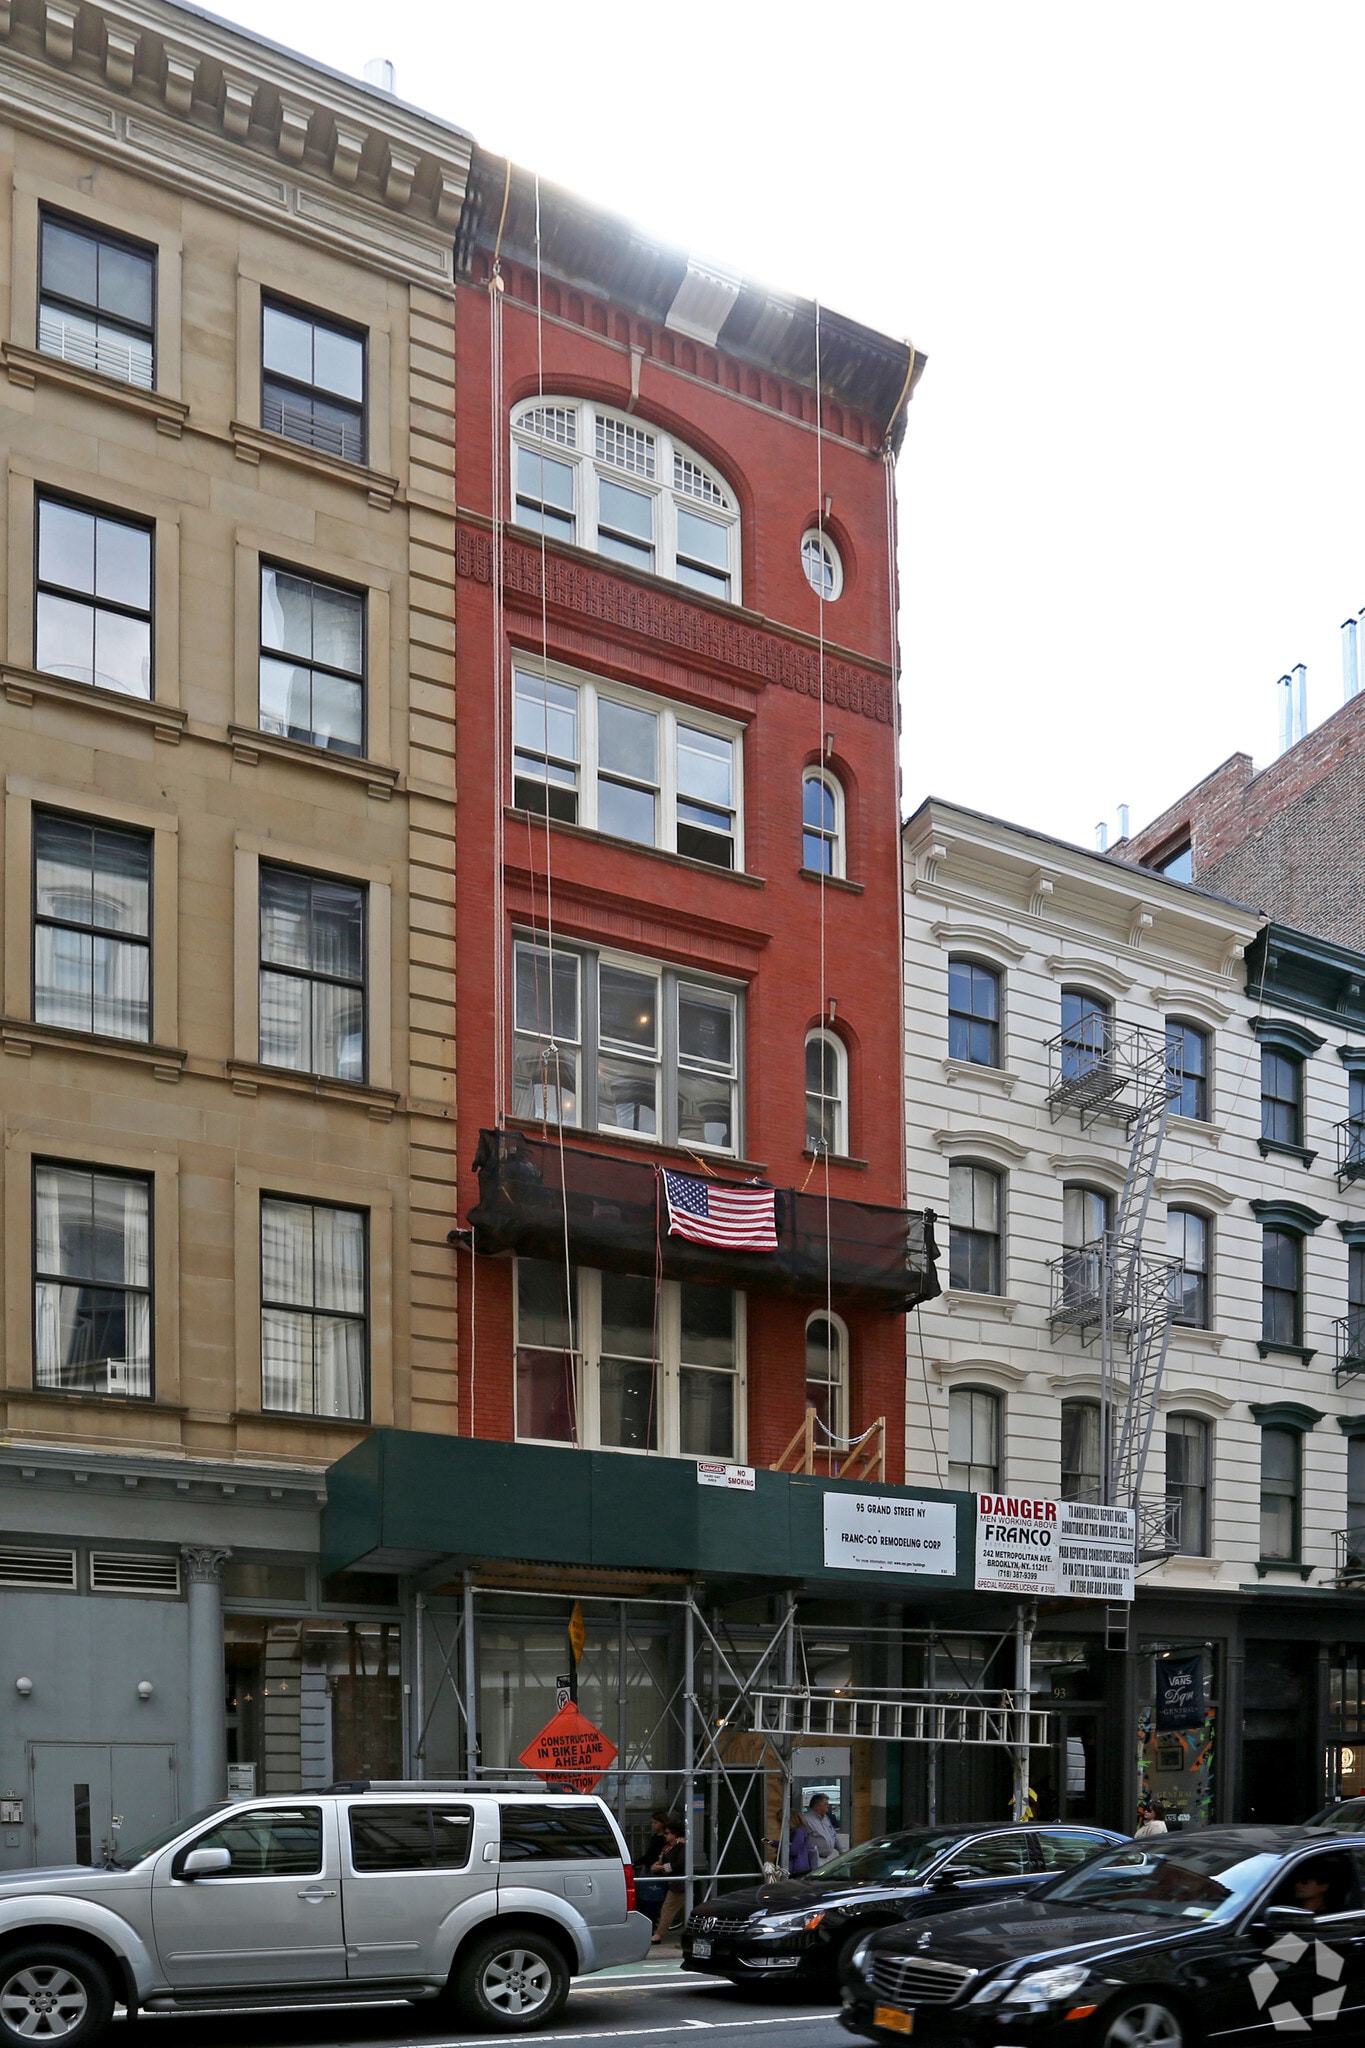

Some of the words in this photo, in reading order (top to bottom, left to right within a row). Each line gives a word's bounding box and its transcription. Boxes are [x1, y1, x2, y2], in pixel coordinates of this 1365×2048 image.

[728, 1477, 754, 1487] SMOKING
[856, 1503, 865, 1513] 95
[867, 1504, 891, 1515] GRAND
[893, 1506, 915, 1517] STREET
[917, 1508, 926, 1518] NY
[980, 1495, 1057, 1521] DANGER
[1068, 1505, 1073, 1518] TO
[1101, 1508, 1114, 1522] REPORT
[1114, 1510, 1127, 1524] UNSAFE
[980, 1515, 996, 1523] MEN
[998, 1517, 1032, 1527] WORKING
[1034, 1520, 1058, 1529] ABOVE
[985, 1524, 1051, 1546] FRANCO
[1062, 1520, 1083, 1535] CONDITIONS
[1084, 1523, 1089, 1535] AT
[1089, 1523, 1098, 1536] THIS
[1098, 1524, 1109, 1537] WORK
[1110, 1525, 1118, 1538] SITE
[1119, 1526, 1127, 1539] CALL
[841, 1533, 878, 1545] FRANC-CO
[880, 1537, 921, 1549] REMODELING
[923, 1540, 941, 1550] CORP
[995, 1551, 1039, 1561] METROPOLITAN
[1040, 1555, 1053, 1563] AVE.
[1059, 1545, 1069, 1559] PARA
[1069, 1546, 1088, 1560] REPORTAR
[998, 1570, 1012, 1578] (718)
[1013, 1571, 1038, 1580] 387-9399
[1062, 1562, 1068, 1575] EN
[1068, 1563, 1074, 1576] UN
[1084, 1564, 1090, 1577] DE
[978, 1580, 997, 1589] SPECIAL
[998, 1582, 1019, 1591] RIGGERS
[1020, 1584, 1039, 1592] LICENSE
[1070, 1579, 1075, 1593] NO
[1168, 1674, 1192, 1686] VANS
[1054, 1688, 1066, 1698] 93
[1163, 1707, 1195, 1715] GENERAL
[541, 1733, 599, 1747] CONSTRUCTION
[538, 1748, 549, 1758] IN
[552, 1745, 577, 1757] BIKE
[581, 1743, 603, 1754] LANE
[555, 1755, 592, 1768] AHEAD
[815, 1756, 826, 1766] 95
